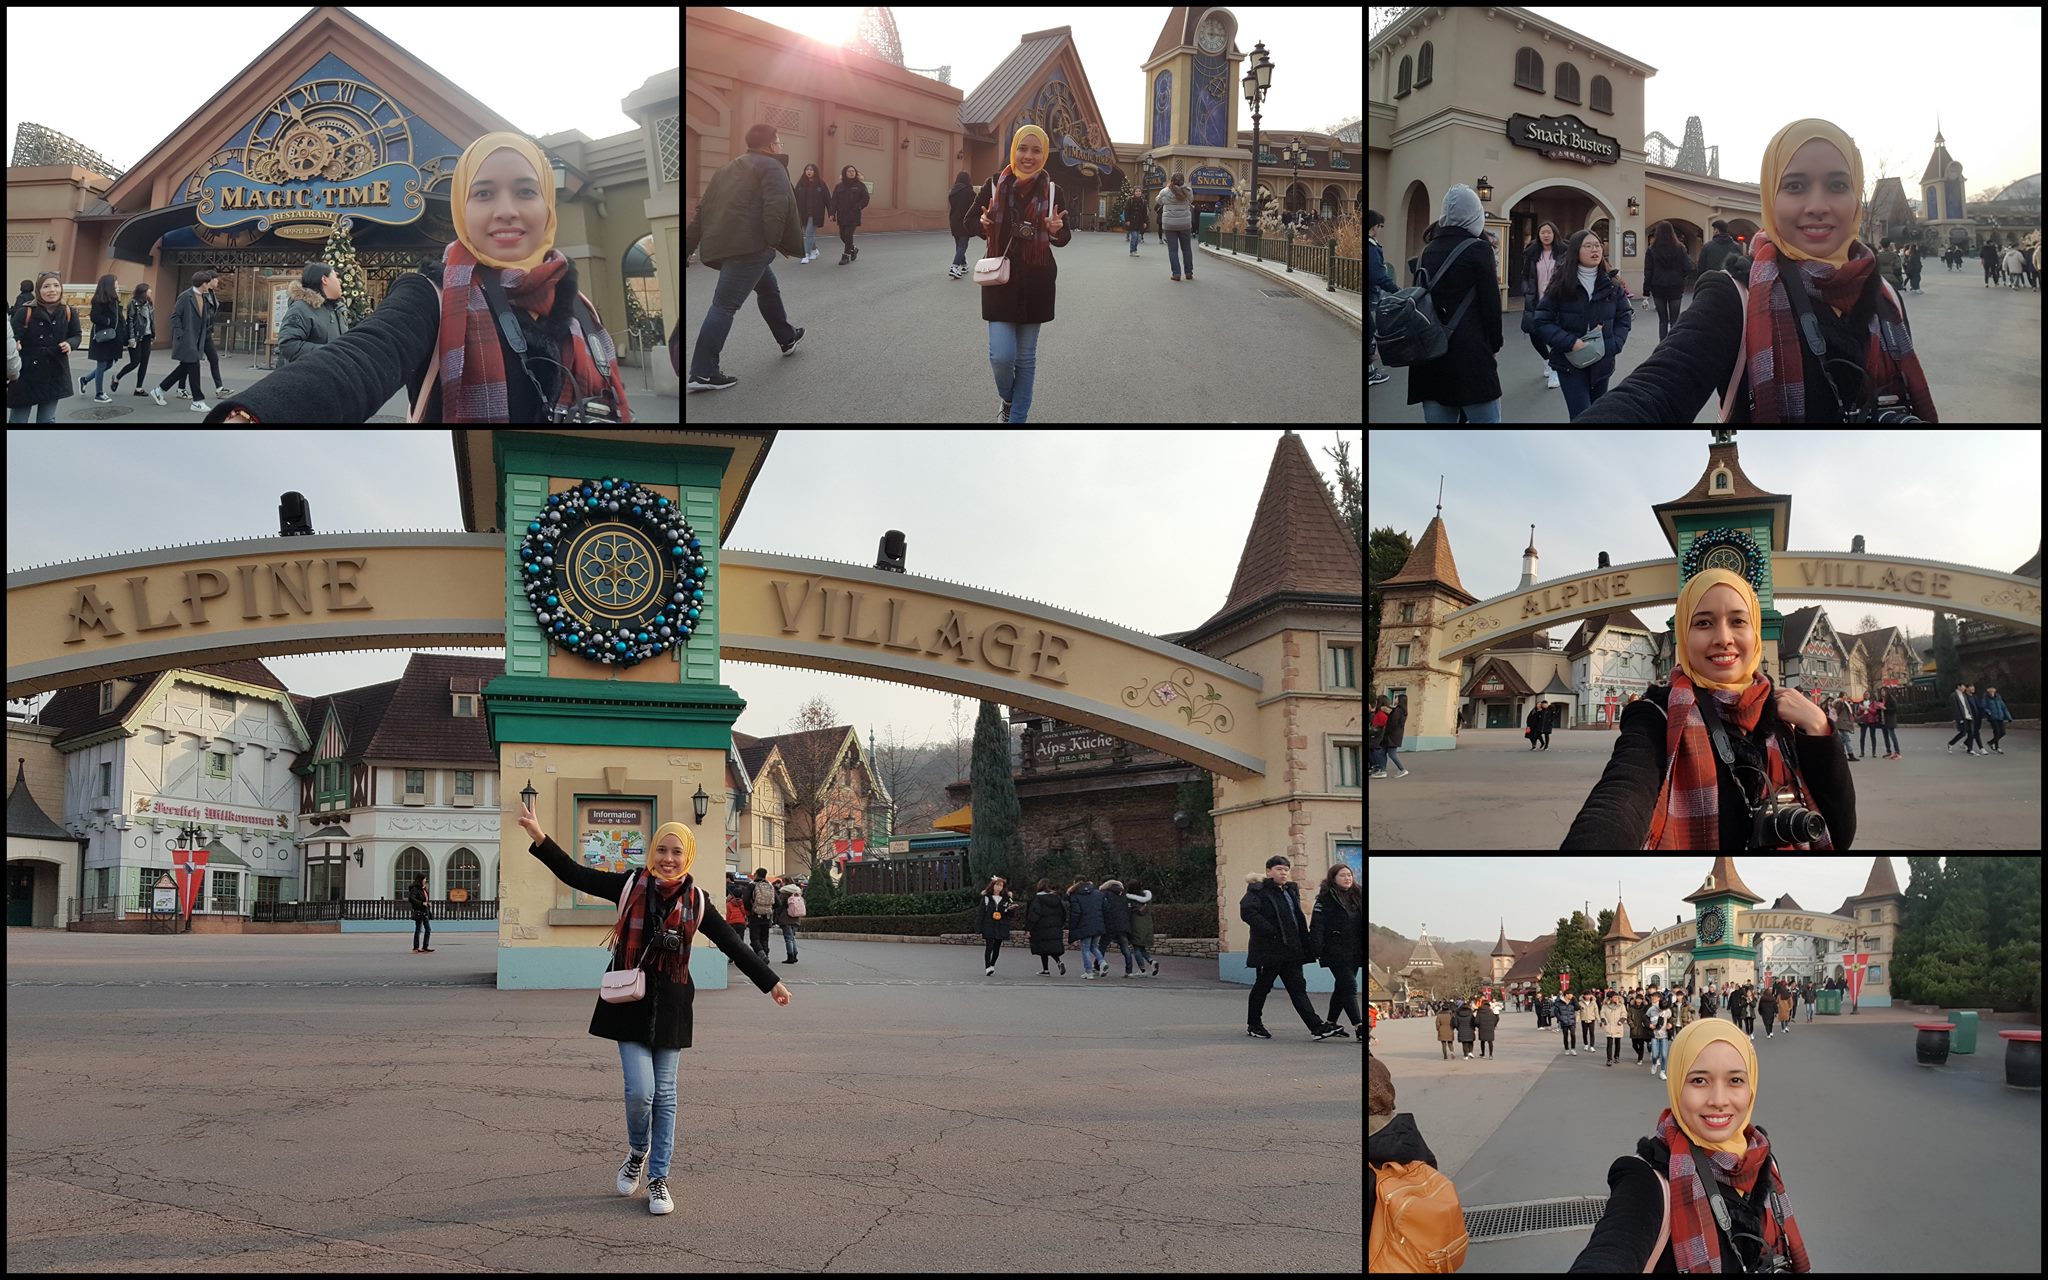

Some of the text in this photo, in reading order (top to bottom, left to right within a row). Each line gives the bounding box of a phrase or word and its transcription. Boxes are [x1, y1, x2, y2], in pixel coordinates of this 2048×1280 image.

[1526, 122, 1613, 156] Snack Busters
[1197, 176, 1228, 186] SNACK
[220, 180, 390, 211] MAGIC TIME
[272, 209, 335, 220] RESTAURANT
[1520, 559, 1952, 619] ALPINE VILLAGE
[63, 557, 1077, 686] ALPINE VILLAGE
[1036, 734, 1113, 760] Alps Küche
[204, 806, 275, 827] Willkommen
[593, 810, 637, 819] Information
[1650, 912, 1815, 950] ALPINE VILLAGE
